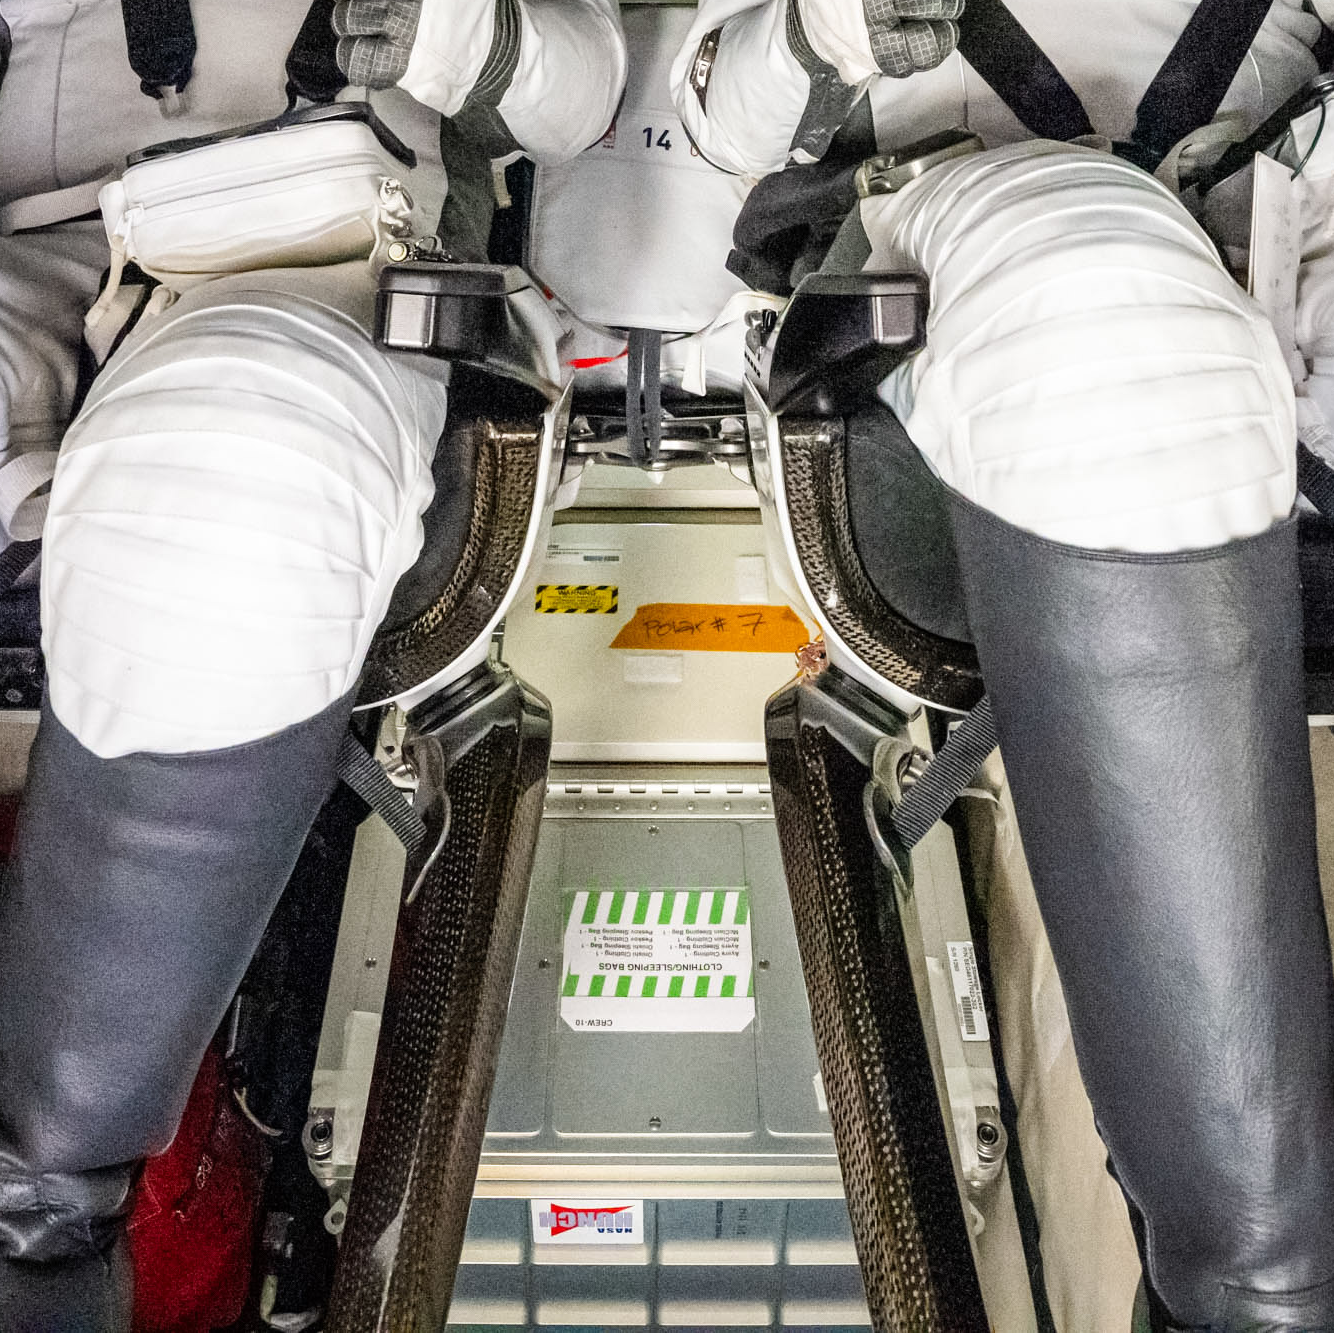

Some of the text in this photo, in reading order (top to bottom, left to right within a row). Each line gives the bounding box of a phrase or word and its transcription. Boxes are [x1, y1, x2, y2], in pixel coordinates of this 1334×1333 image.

[643, 127, 672, 151] 14
[710, 616, 727, 633] #
[738, 612, 766, 636] 7
[598, 962, 723, 972] CLOTHING/SLEEPING BAGS
[575, 1019, 613, 1027] CREW-10
[539, 1212, 633, 1228] HUNCH
